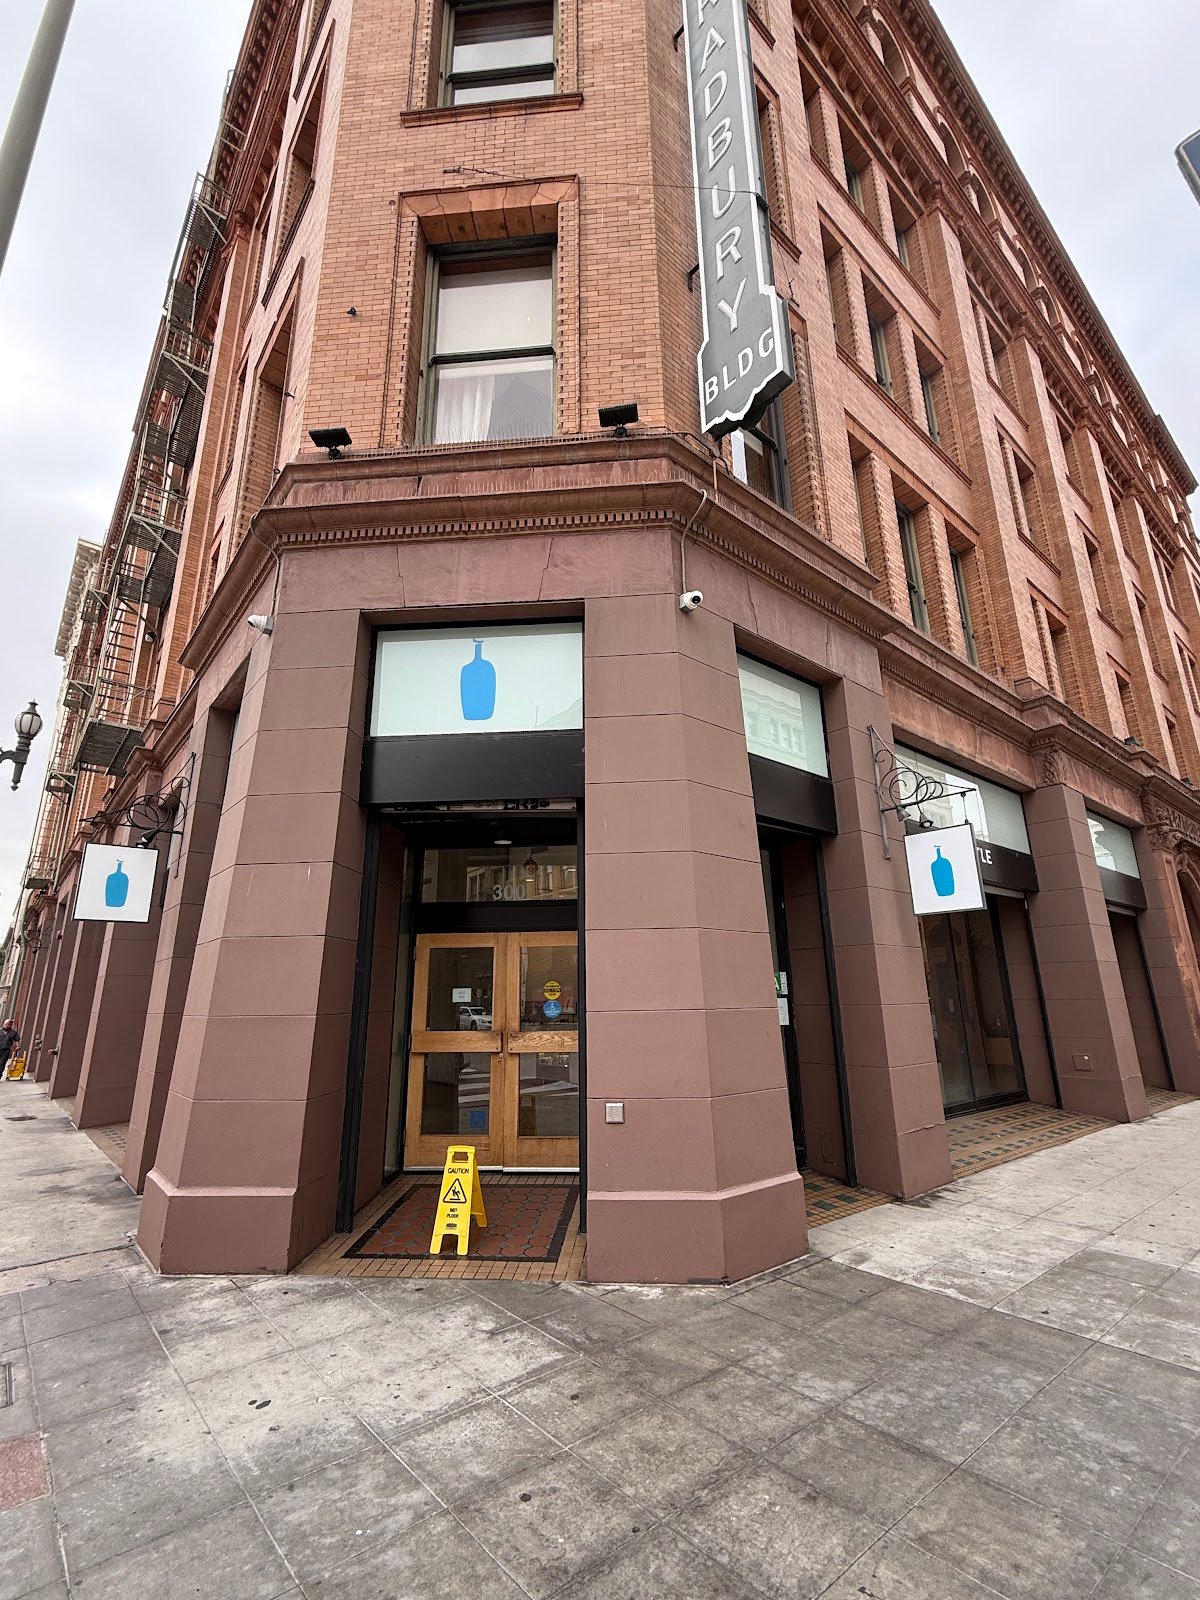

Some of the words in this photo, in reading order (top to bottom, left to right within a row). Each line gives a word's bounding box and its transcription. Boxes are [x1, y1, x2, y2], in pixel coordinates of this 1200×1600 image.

[704, 326, 775, 406] BLDG
[976, 846, 993, 865] LE
[492, 884, 526, 901] 300
